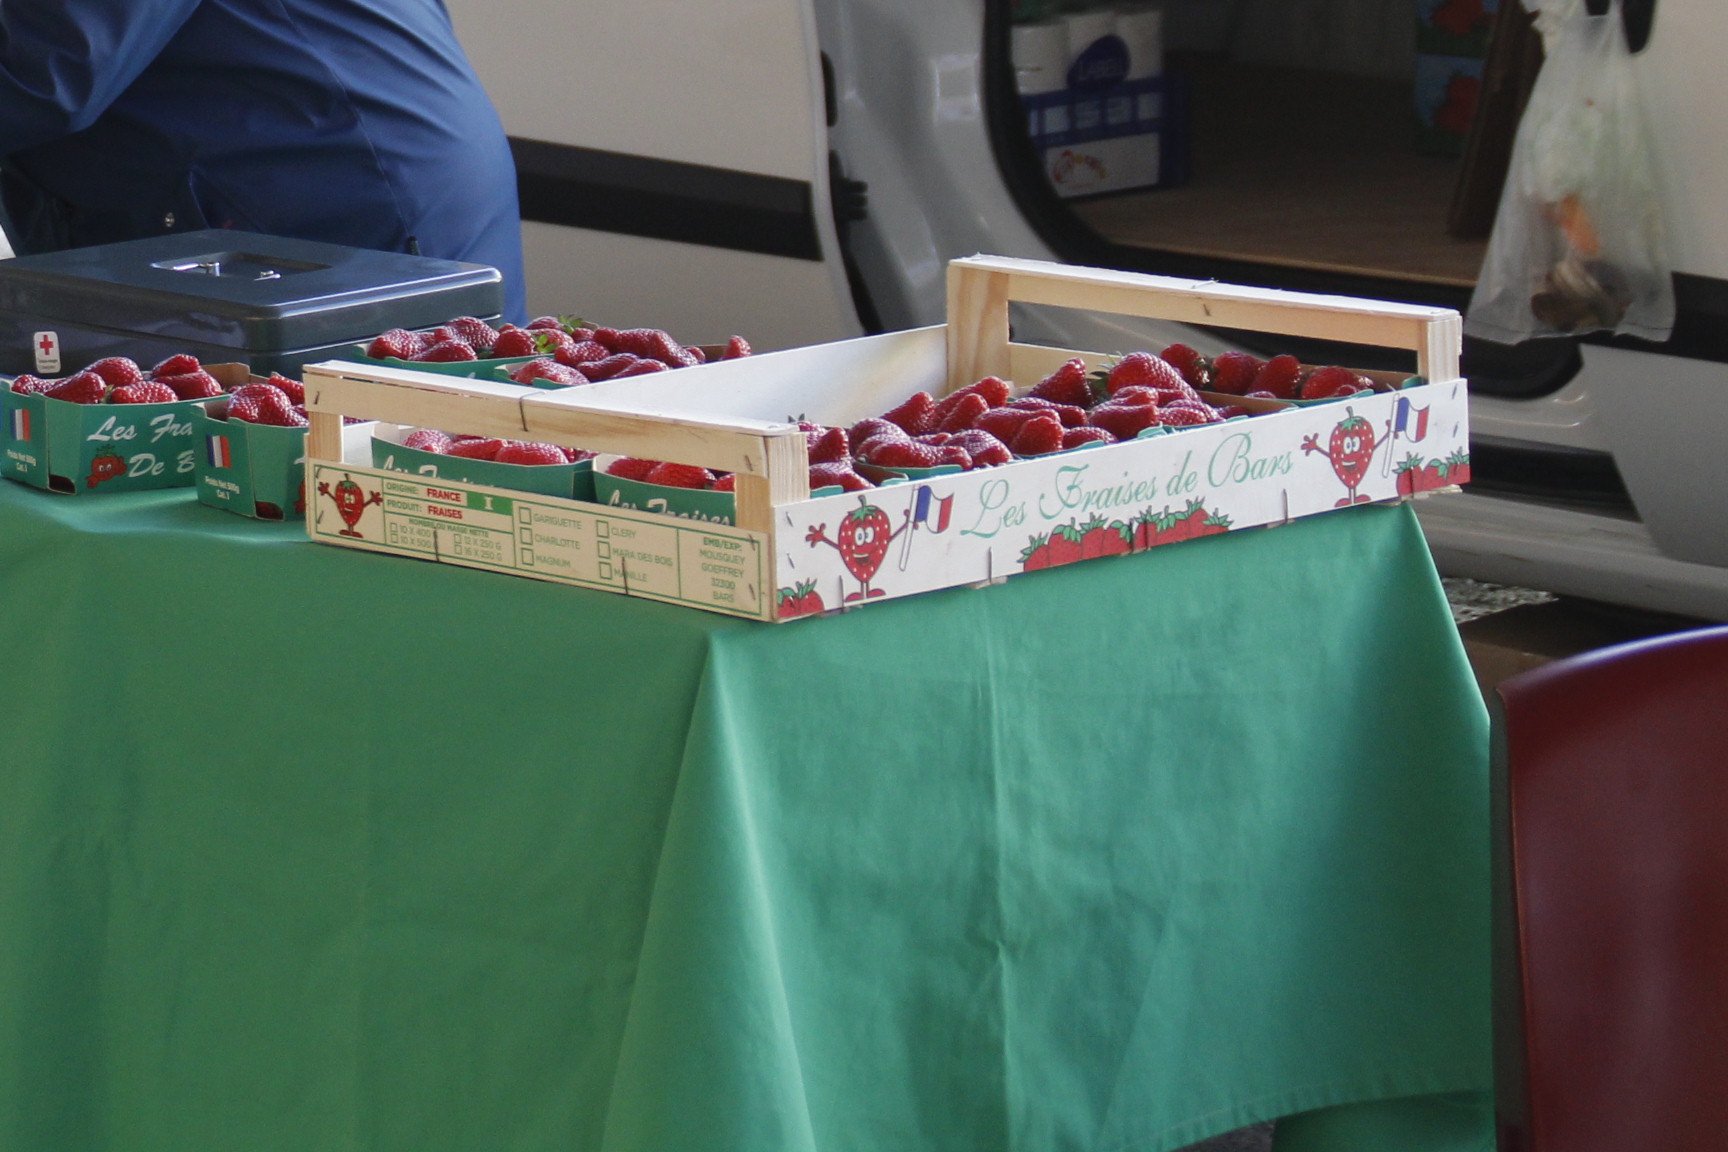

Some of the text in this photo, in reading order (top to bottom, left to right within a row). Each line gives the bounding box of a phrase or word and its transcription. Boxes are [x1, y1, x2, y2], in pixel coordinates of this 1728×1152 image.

[86, 415, 138, 442] Les
[128, 453, 165, 478] De
[960, 431, 1295, 539] Les Fraises de Bars
[427, 488, 462, 503] FRANCE
[427, 505, 463, 520] FRAISES
[532, 512, 582, 530] GARIGUETTE
[534, 533, 581, 549] CHARLOTTE
[611, 527, 636, 539] CLERY
[535, 555, 571, 568] MAGNUM
[612, 547, 674, 567] MARA DES BOIS
[699, 548, 746, 565] MOUSQUEY
[712, 590, 735, 603] BARS
